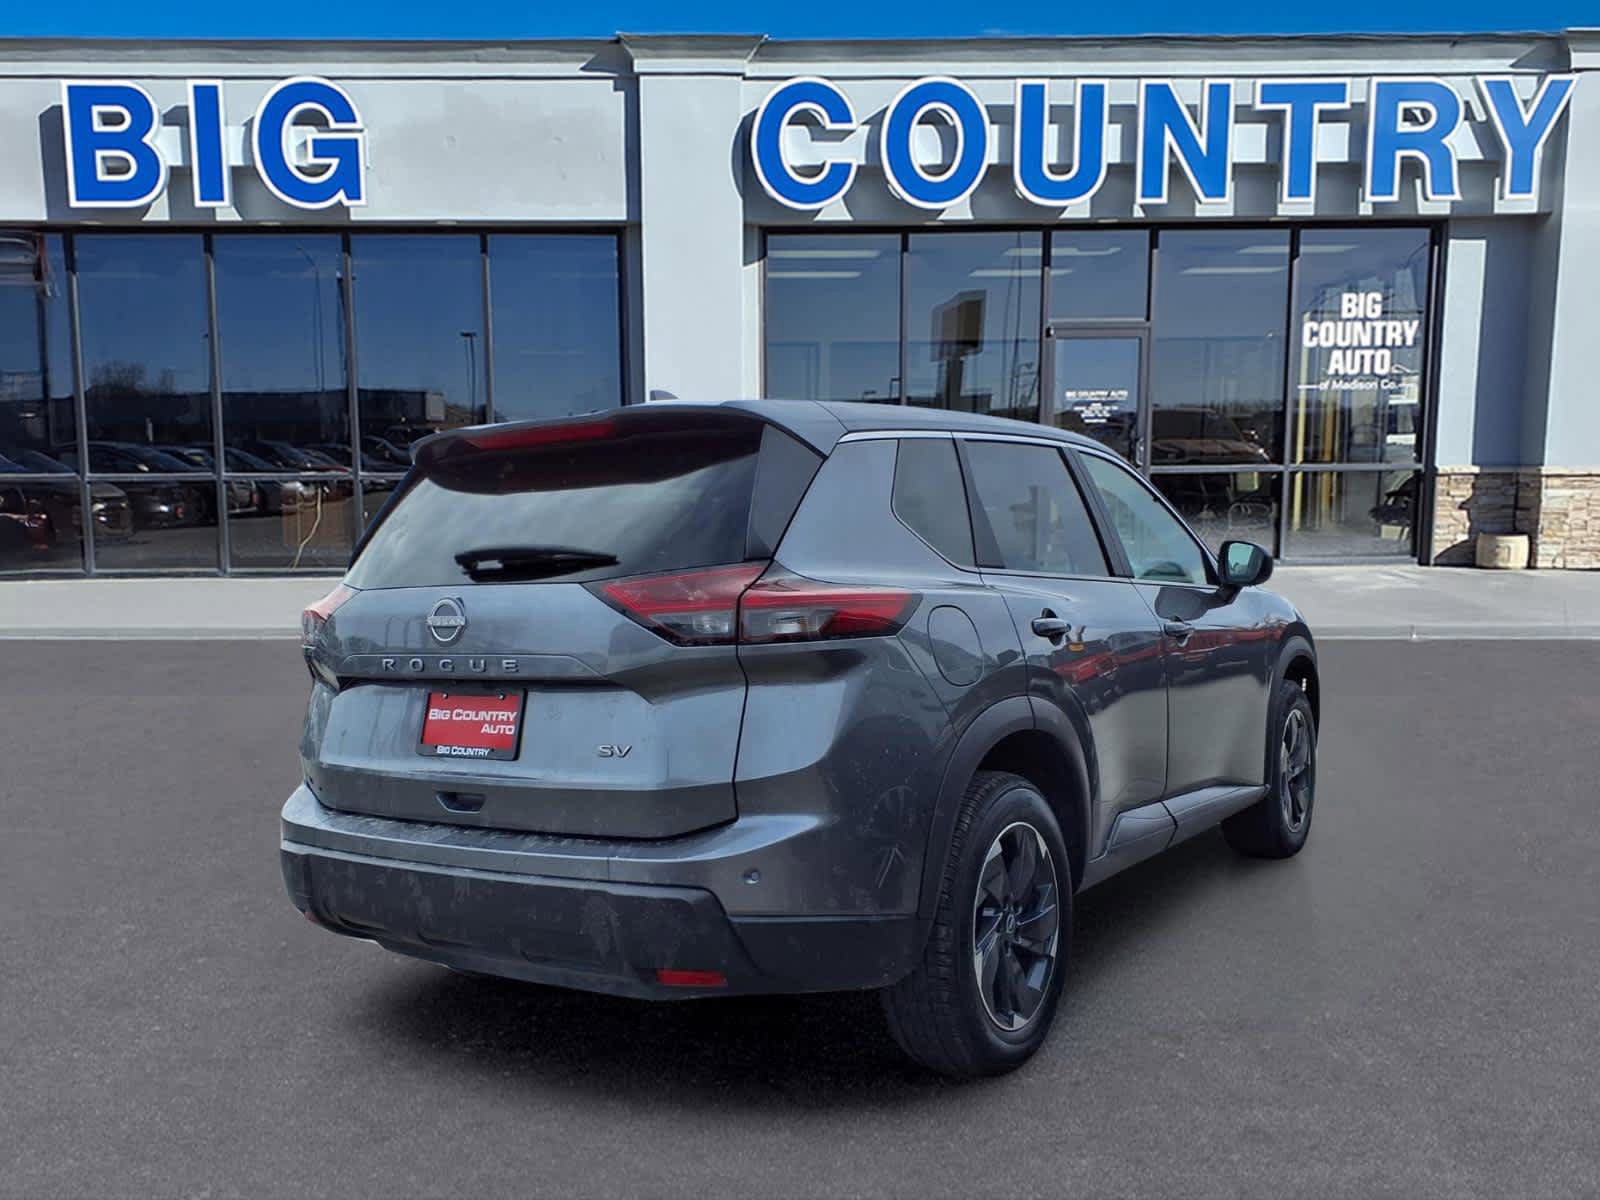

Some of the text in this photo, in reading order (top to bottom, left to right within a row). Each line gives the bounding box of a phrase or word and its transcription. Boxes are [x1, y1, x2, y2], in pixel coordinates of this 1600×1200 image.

[61, 76, 1575, 213] BIG COUNTRY
[1341, 292, 1383, 319] BIG
[1302, 320, 1420, 348] COUNTRY
[1327, 349, 1392, 376] AUTO
[1331, 379, 1378, 390] Madison
[383, 658, 519, 673] ROGUE
[480, 723, 516, 735] AUTO
[598, 744, 632, 758] SV
